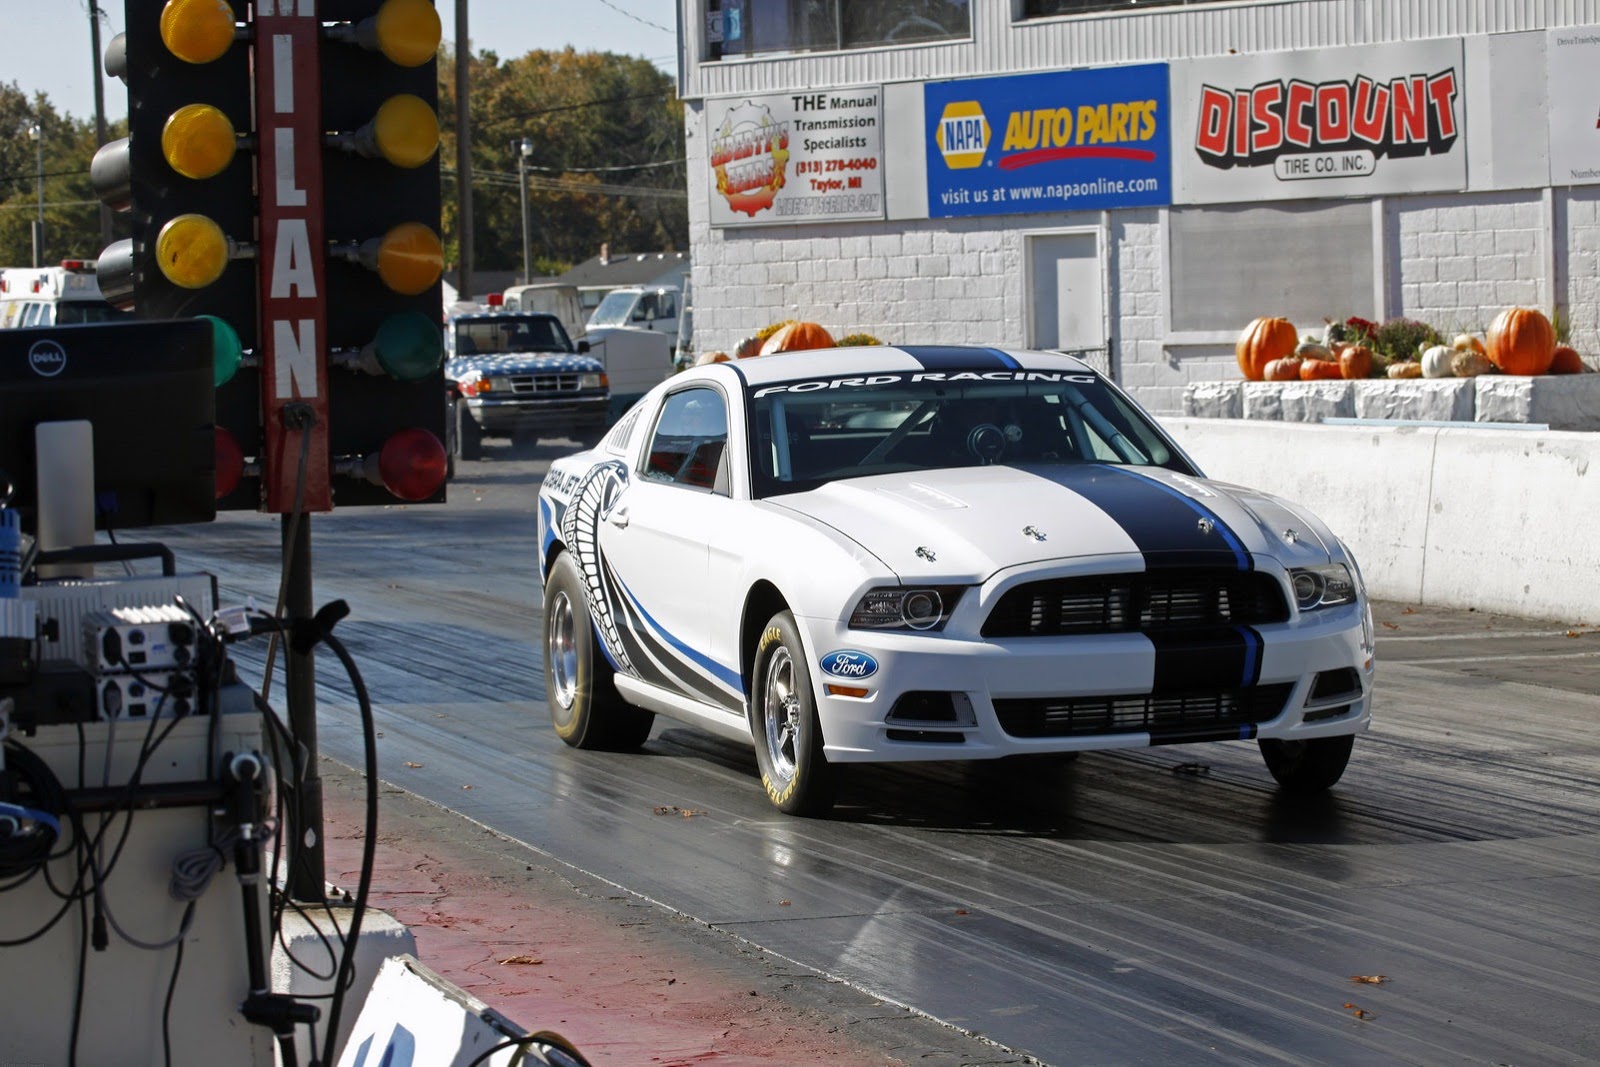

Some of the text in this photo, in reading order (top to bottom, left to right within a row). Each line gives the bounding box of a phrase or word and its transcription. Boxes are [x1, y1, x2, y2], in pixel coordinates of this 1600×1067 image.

[792, 94, 877, 112] THE Manual
[794, 115, 876, 131] Transmission
[1002, 99, 1158, 151] AUTO PARTS
[1195, 67, 1458, 170] DISCOUNT
[804, 136, 867, 154] Specialists
[945, 119, 983, 151] NAPA
[796, 157, 877, 176] (313) 278-4040
[1284, 155, 1367, 174] TIRE CO. INC.
[810, 176, 862, 193] Taylor, MI
[941, 177, 1158, 205] visit us at www.napaonline.com
[257, 0, 318, 398] ILAN
[33, 352, 62, 363] DELL
[753, 371, 1096, 399] FORD RACING
[760, 626, 781, 652] EAGLE
[831, 653, 866, 676] Ford
